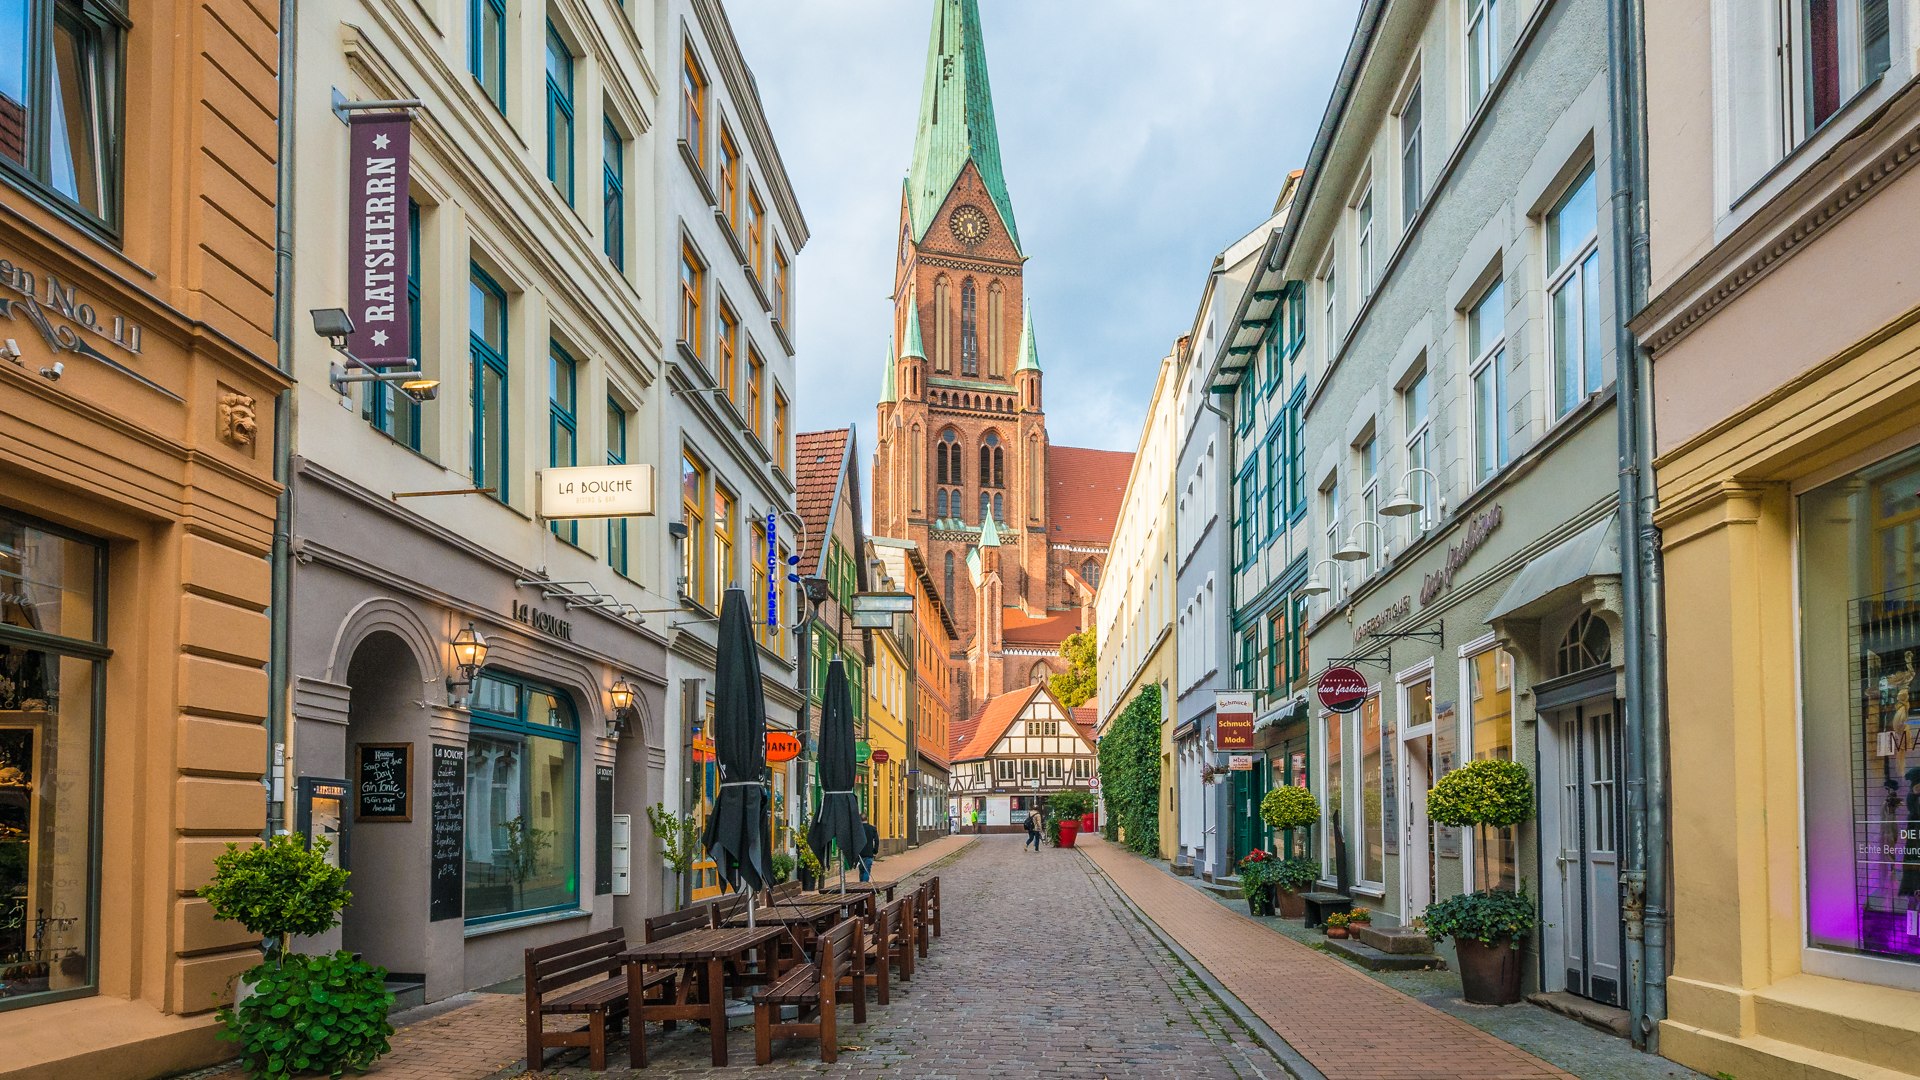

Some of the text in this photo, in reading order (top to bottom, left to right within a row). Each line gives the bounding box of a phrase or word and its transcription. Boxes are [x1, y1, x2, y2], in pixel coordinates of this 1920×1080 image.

[365, 157, 396, 323] RATSHERRN
[45, 273, 103, 332] No.
[113, 315, 143, 355] 11
[559, 479, 633, 495] LA BOUCHE
[767, 514, 777, 627] CONTACTLINSEN
[512, 599, 573, 642] LA BOUCHE
[1318, 683, 1368, 696] duo fashion
[1218, 720, 1252, 728] Schmuck
[1224, 736, 1246, 744] Mode
[434, 748, 464, 760] LA BOUCHE
[363, 762, 380, 772] Soup
[362, 779, 401, 793] Gin Tonic
[1900, 829, 1917, 840] DIE
[1859, 844, 1881, 854] Echte
